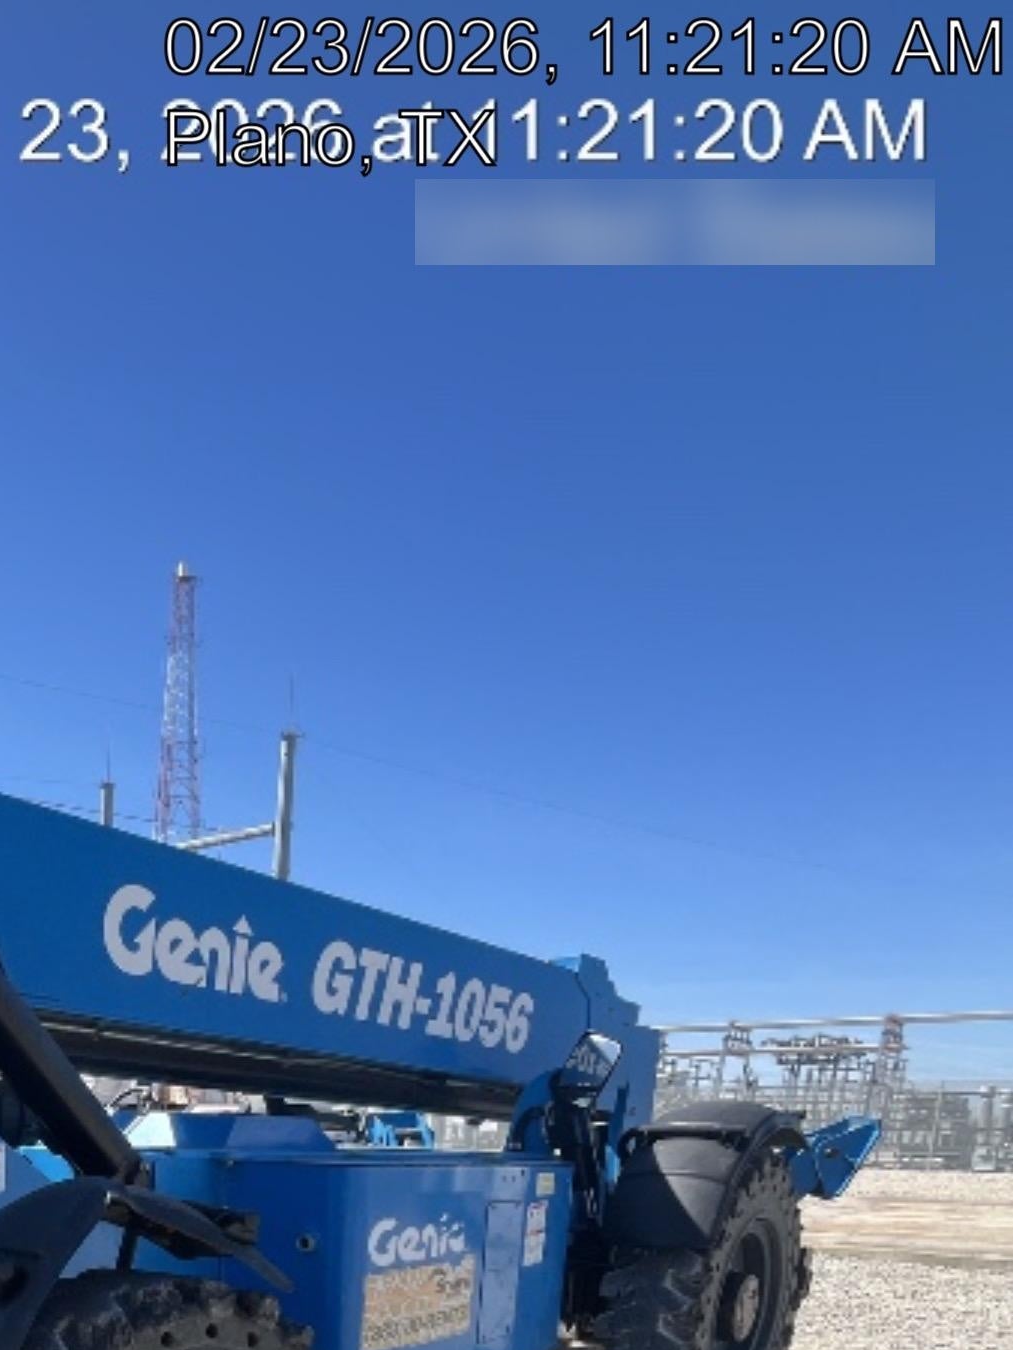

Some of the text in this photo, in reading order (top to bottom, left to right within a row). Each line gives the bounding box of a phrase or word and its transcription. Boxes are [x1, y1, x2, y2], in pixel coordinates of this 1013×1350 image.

[103, 884, 285, 1002] Genie
[312, 940, 534, 1054] GTH-1056
[368, 1213, 468, 1267] Genie
